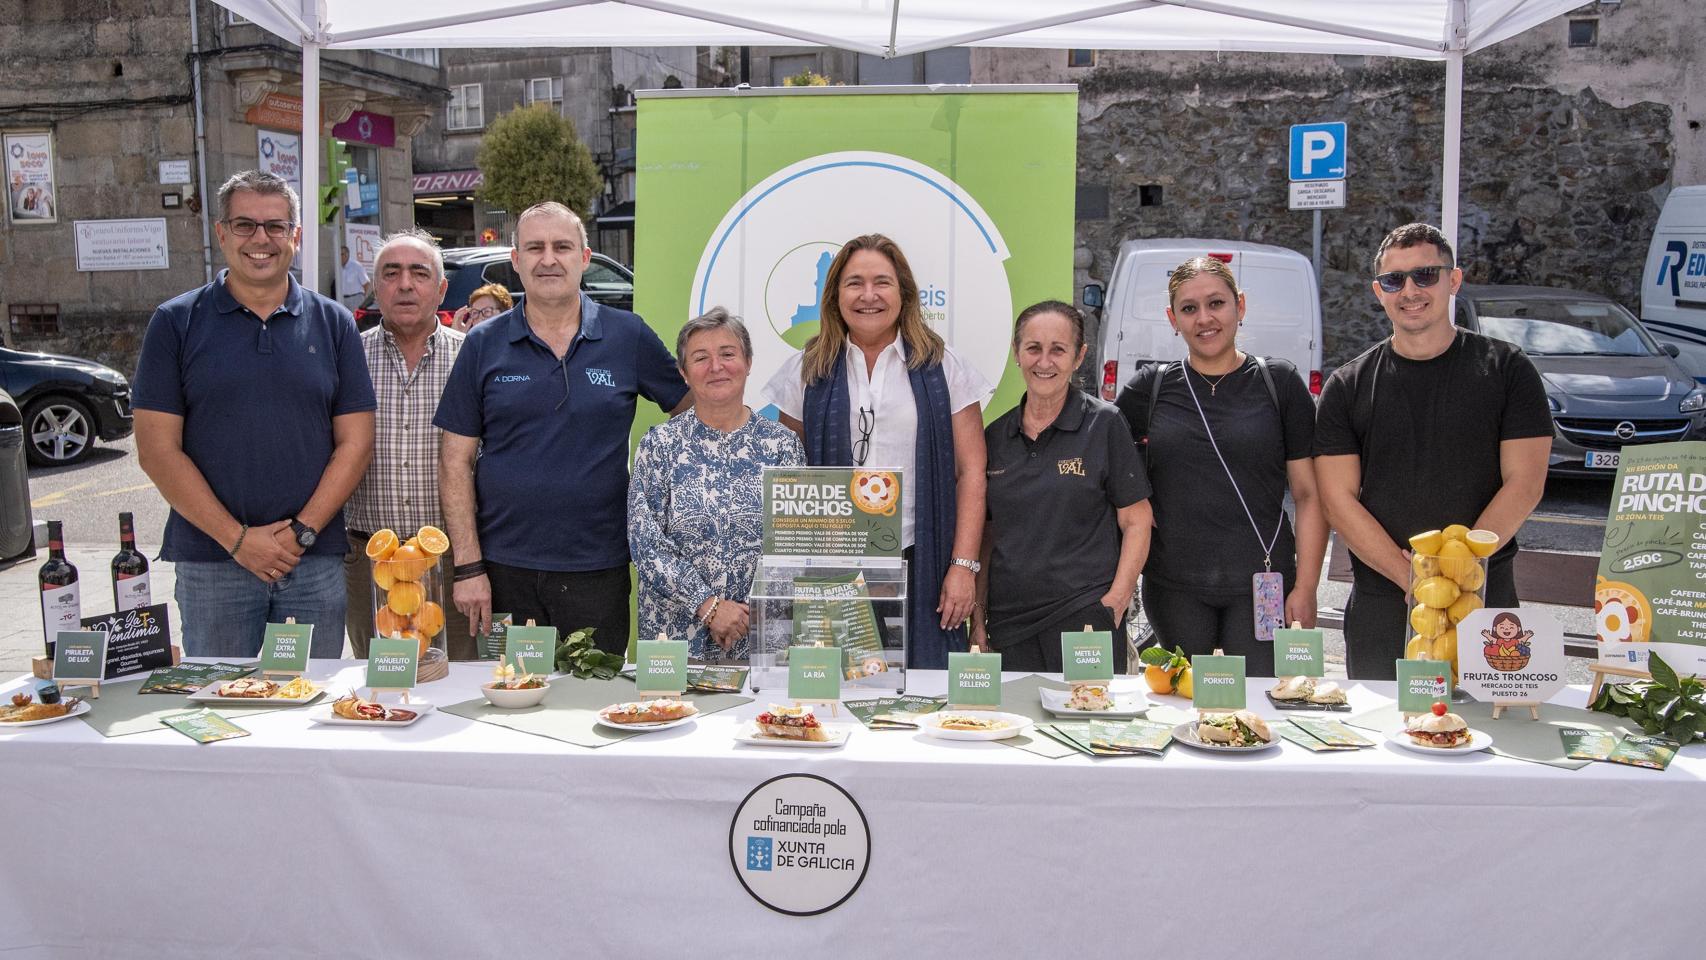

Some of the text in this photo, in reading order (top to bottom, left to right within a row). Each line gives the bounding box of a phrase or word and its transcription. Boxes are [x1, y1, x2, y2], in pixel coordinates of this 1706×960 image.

[1302, 130, 1336, 175] P
[413, 173, 484, 191] ORNIA
[922, 310, 945, 321] berto
[502, 375, 531, 383] DORNA
[586, 372, 616, 388] VAL
[1057, 461, 1085, 477] VAL
[1636, 463, 1666, 472] EDICIÓN
[1621, 472, 1685, 493] RUTA
[772, 484, 846, 500] RUTA DE
[772, 500, 853, 516] PINCHOS
[1617, 493, 1706, 514] PINCHO
[1623, 552, 1663, 571] 2,50€
[1652, 597, 1693, 608] CAFÉ-BAR
[1678, 630, 1694, 638] LAS
[120, 659, 139, 667] Gourmet
[374, 655, 410, 665] PAÑUELITO
[650, 659, 673, 667] TOSTA
[813, 671, 826, 679] RÍA
[1203, 677, 1235, 685] PORKITO
[1463, 673, 1558, 682] FRUTAS TRONCOSO
[959, 680, 991, 688] RELLENO
[775, 798, 826, 821] Campaña
[753, 815, 847, 838] cofinanciada pola
[777, 840, 825, 855] XUNTA
[777, 855, 855, 871] DE GALICIA
